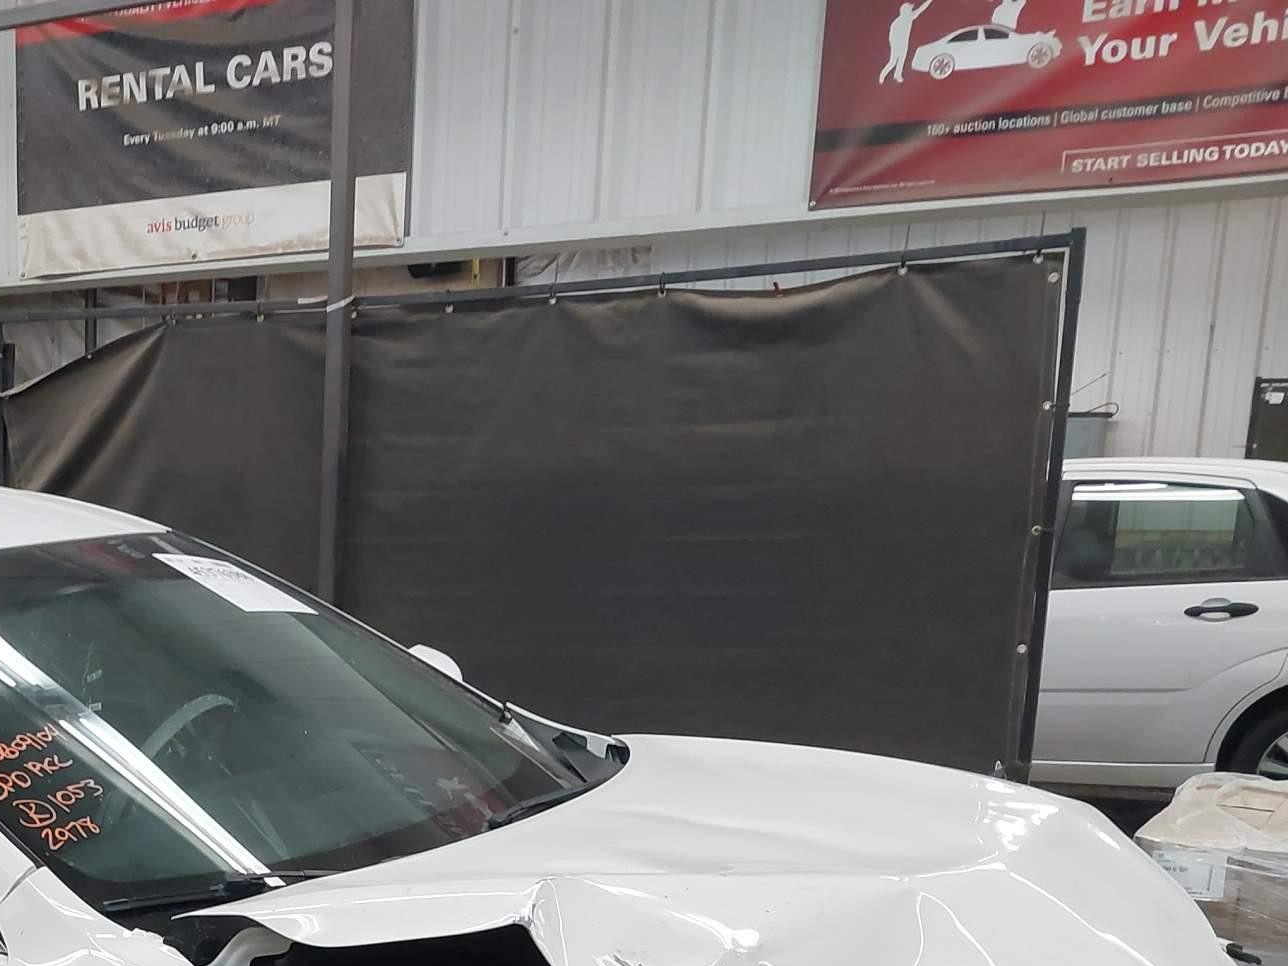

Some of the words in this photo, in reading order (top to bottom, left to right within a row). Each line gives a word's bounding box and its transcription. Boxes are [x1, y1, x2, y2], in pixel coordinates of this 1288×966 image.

[1077, 32, 1178, 66] Your
[77, 61, 216, 112] RENTAL
[226, 41, 333, 90] CARS
[953, 119, 996, 135] auction
[998, 114, 1051, 130] locations
[1061, 108, 1100, 125] Global
[1100, 103, 1159, 121] customer
[1161, 98, 1193, 115] base
[1202, 87, 1281, 110] Competitive
[123, 133, 151, 147] Every
[153, 127, 195, 142] Tuday
[198, 124, 209, 136] at
[1071, 154, 1131, 174] START
[1136, 146, 1220, 168] SELLING
[146, 217, 172, 234] avis
[174, 215, 220, 233] budget
[221, 212, 255, 230] group
[46, 778, 104, 813] 1053
